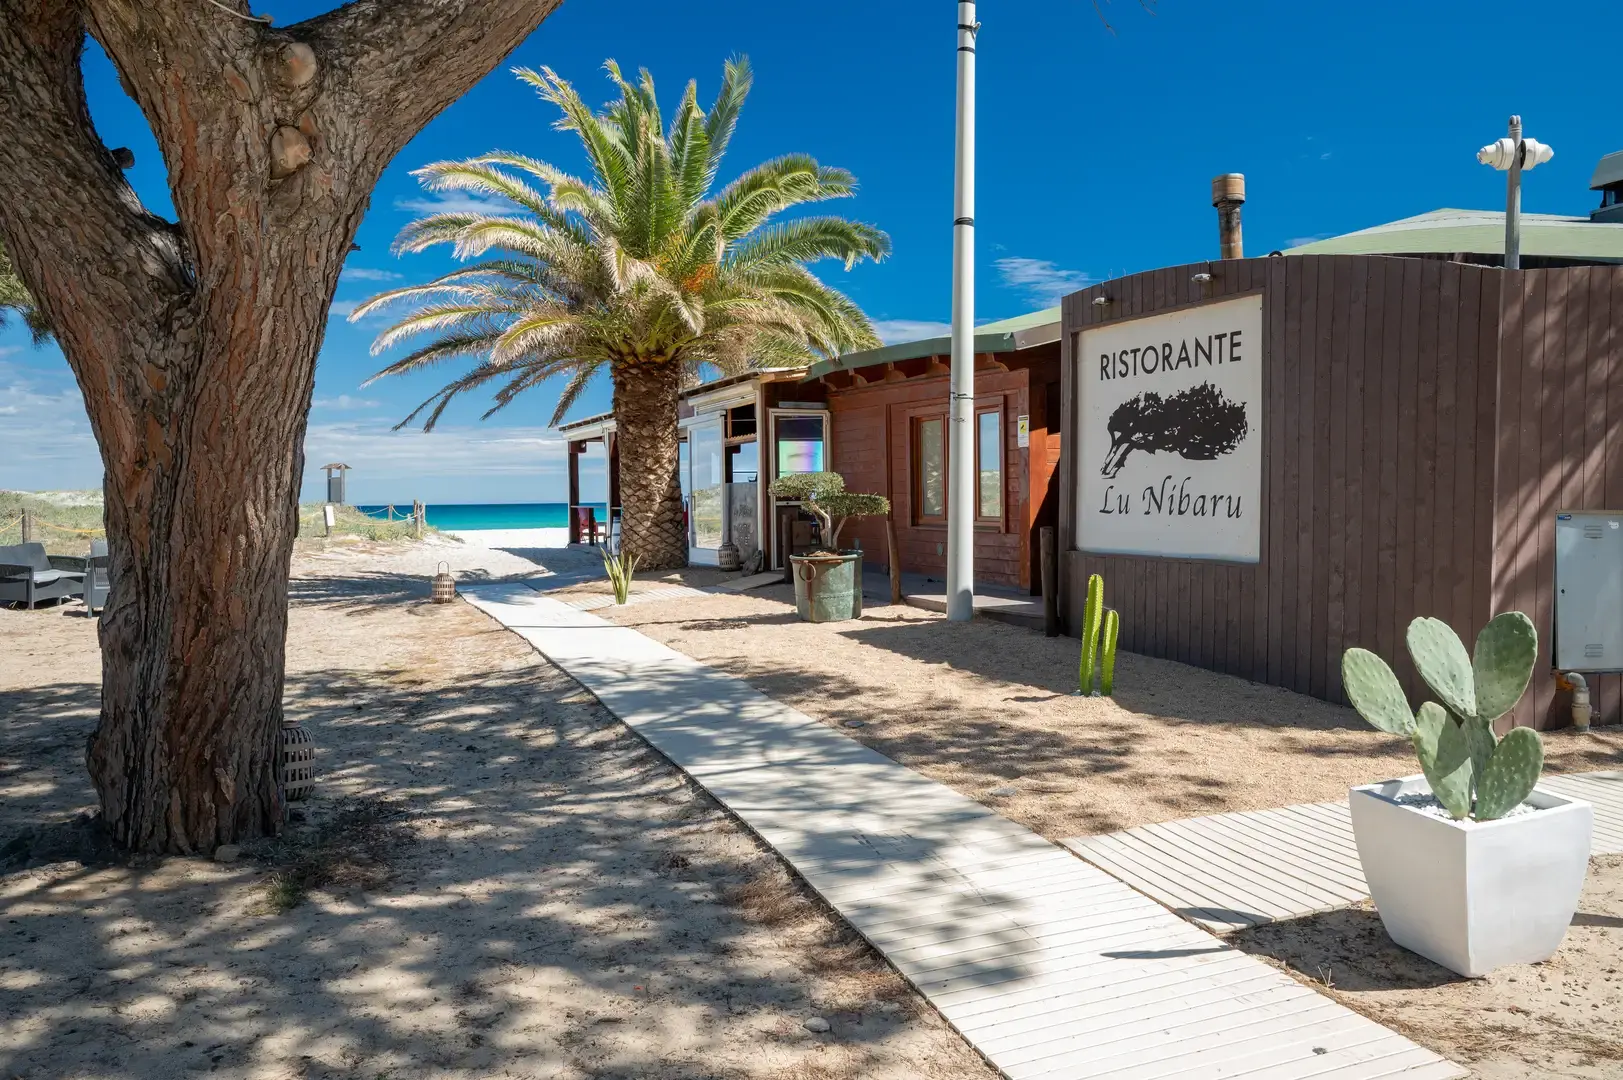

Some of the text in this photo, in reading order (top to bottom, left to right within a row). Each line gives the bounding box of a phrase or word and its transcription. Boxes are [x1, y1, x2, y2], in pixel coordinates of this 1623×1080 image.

[1100, 330, 1242, 381] RISTORANTE
[1099, 475, 1243, 519] Lu Nibaru
